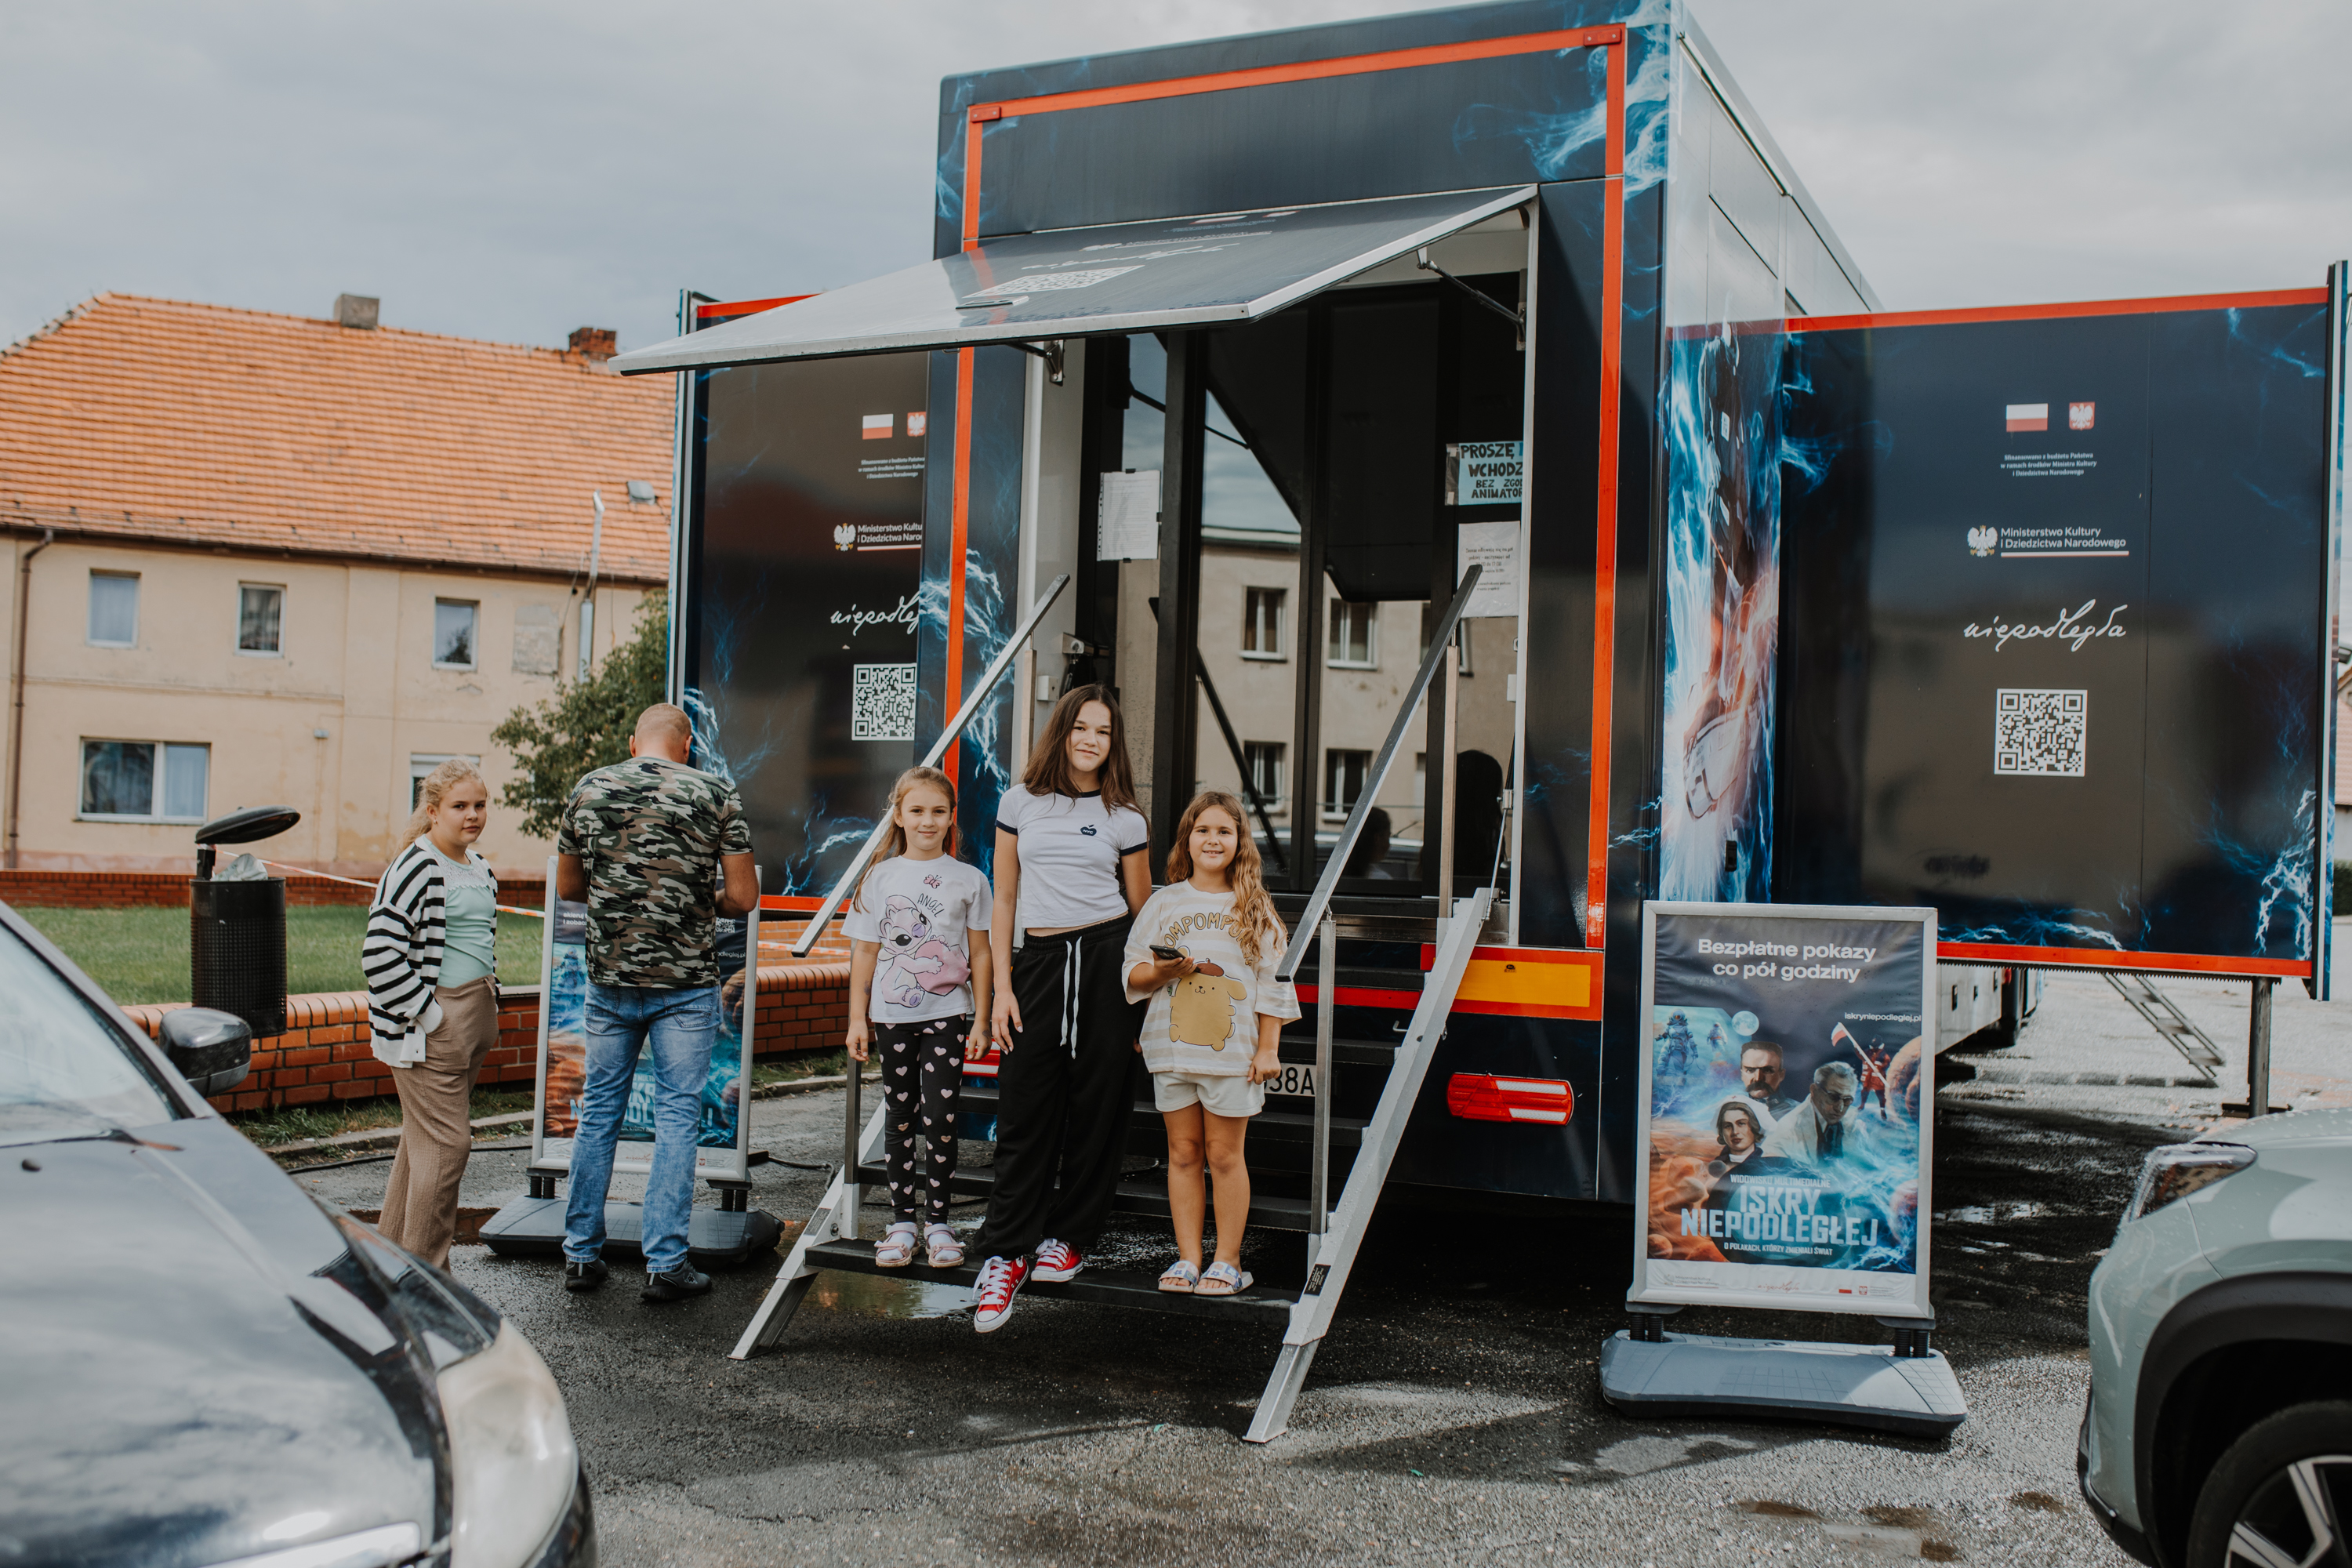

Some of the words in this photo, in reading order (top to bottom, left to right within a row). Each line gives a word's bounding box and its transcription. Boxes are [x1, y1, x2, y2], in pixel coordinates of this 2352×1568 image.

[1461, 443, 1515, 459] PROSZĘ
[1475, 479, 1495, 488] BEZ
[858, 524, 902, 533] Ministerstwo
[2000, 527, 2063, 537] Ministerstwo
[2064, 526, 2101, 538] Kultury
[857, 535, 860, 543] i
[861, 533, 902, 543] Dziedzictwa
[2000, 539, 2003, 548] i
[2005, 538, 2063, 549] Dziedzictwa
[2064, 537, 2126, 549] Narodowego
[917, 893, 945, 918] ANGEL
[717, 950, 746, 959] odleglej.pl
[1698, 938, 1798, 958] Bezpłatne
[1803, 943, 1877, 963] pokazy
[1712, 963, 1739, 976] co
[1743, 961, 1777, 979] pół
[1780, 964, 1860, 983] godziny
[1264, 1066, 1316, 1095] 38A
[1730, 1174, 1773, 1185] WIDOWISKO
[1774, 1176, 1831, 1188] MULTIMEDIALNE
[1740, 1185, 1821, 1216] ISKRY
[1681, 1207, 1878, 1247] NIEPODLEGŁEJ
[1730, 1242, 1761, 1252] POLAKACH,
[1762, 1243, 1784, 1253] KTÓRZY
[1785, 1245, 1813, 1254] ZMIENIALI
[1814, 1246, 1833, 1256] ŚWIAT
